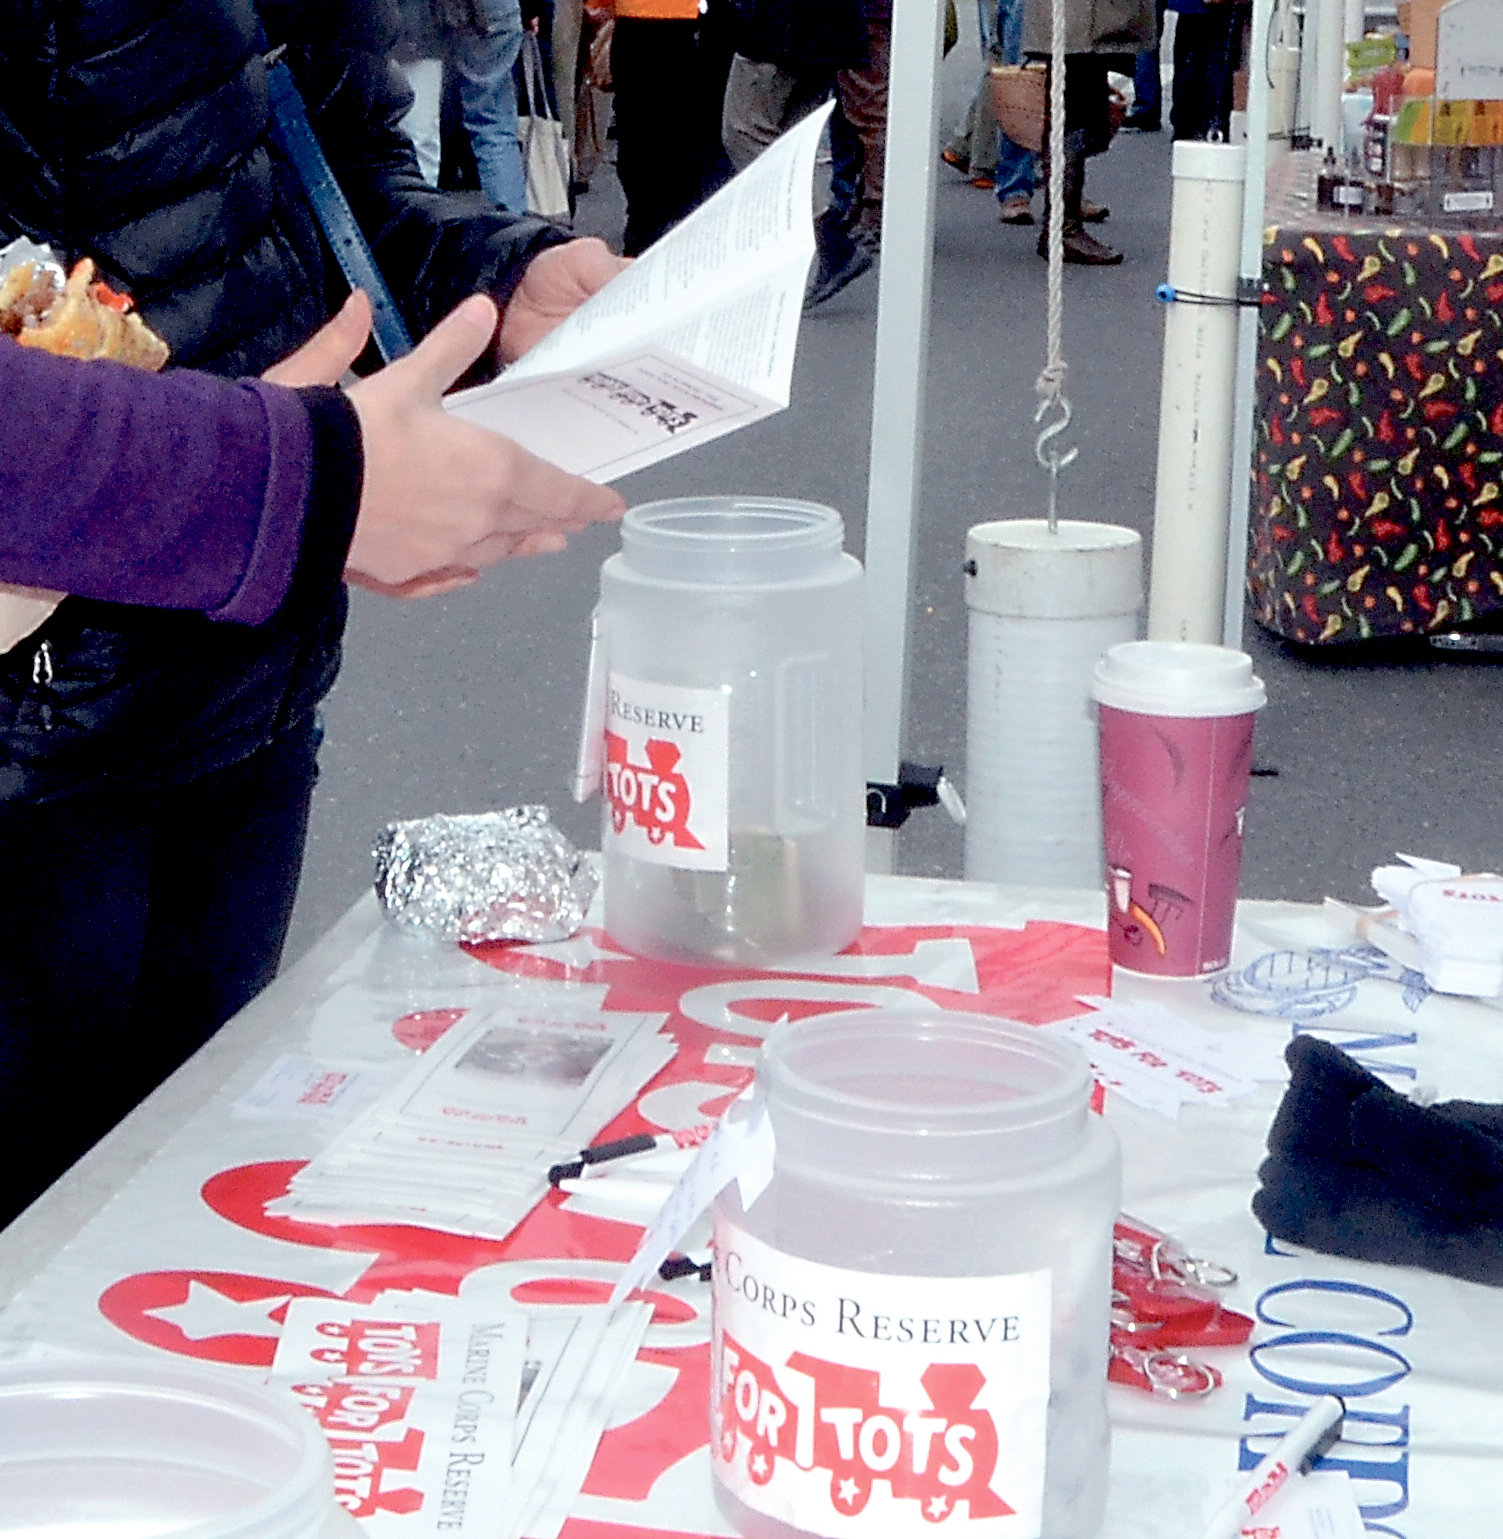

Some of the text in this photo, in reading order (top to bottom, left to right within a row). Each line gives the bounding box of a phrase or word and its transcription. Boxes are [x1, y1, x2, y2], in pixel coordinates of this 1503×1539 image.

[610, 688, 705, 734] RESERVE
[607, 762, 676, 823] TOTS
[725, 1251, 1021, 1344] CORPS RESERVE
[358, 1324, 422, 1376] TOYS
[326, 1384, 401, 1428] FOR
[436, 1322, 506, 1530] MARINE CORPS RESERVE
[724, 1346, 977, 1488] FOR TOTS
